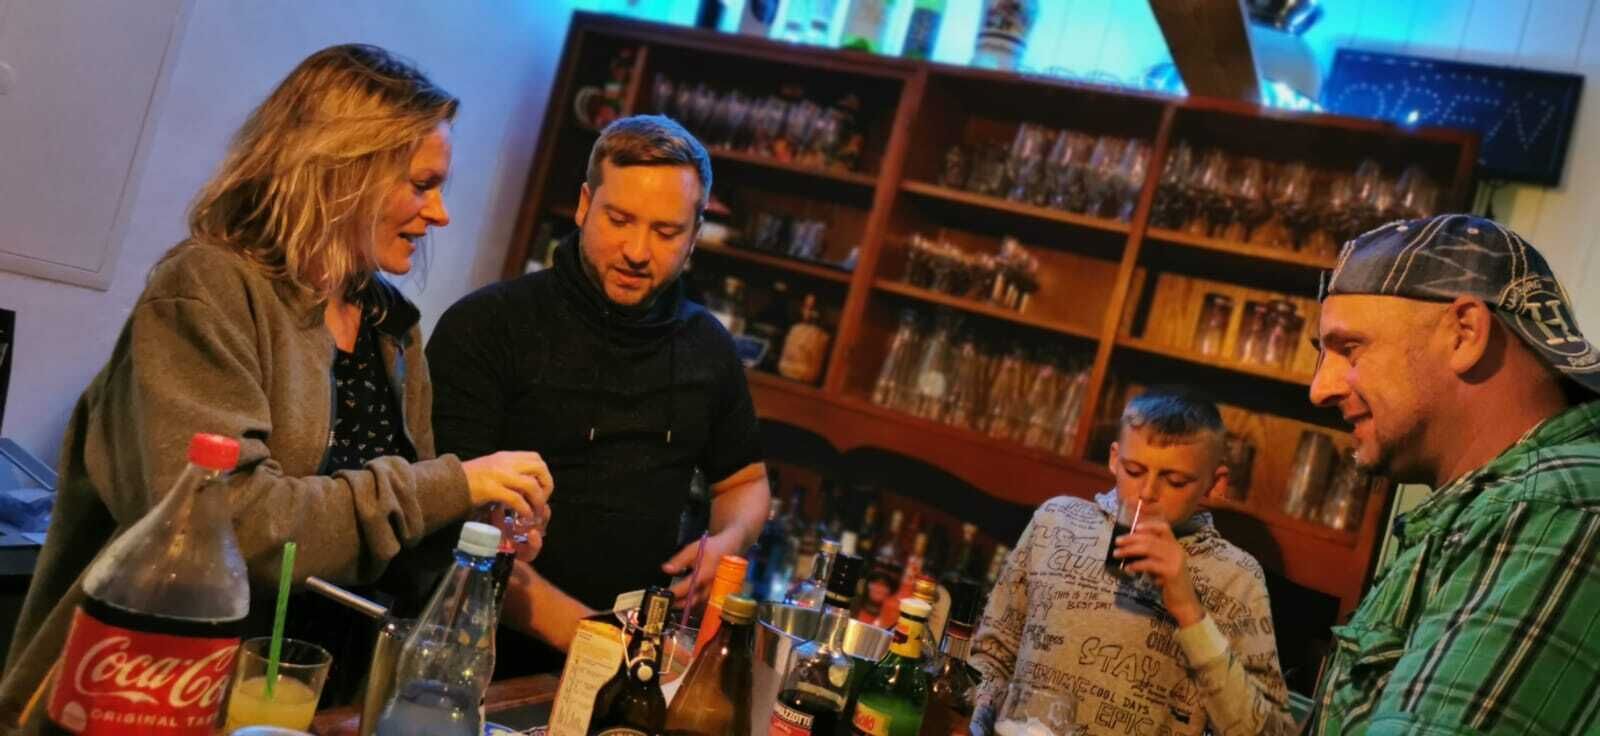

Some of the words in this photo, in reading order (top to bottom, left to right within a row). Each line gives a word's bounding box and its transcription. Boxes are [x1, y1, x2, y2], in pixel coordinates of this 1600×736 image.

[1079, 636, 1160, 684] STAY
[1090, 684, 1116, 703] COOL
[1123, 697, 1150, 715] DAYS
[90, 706, 179, 728] ORIGINAL
[1095, 702, 1154, 736] EPIC
